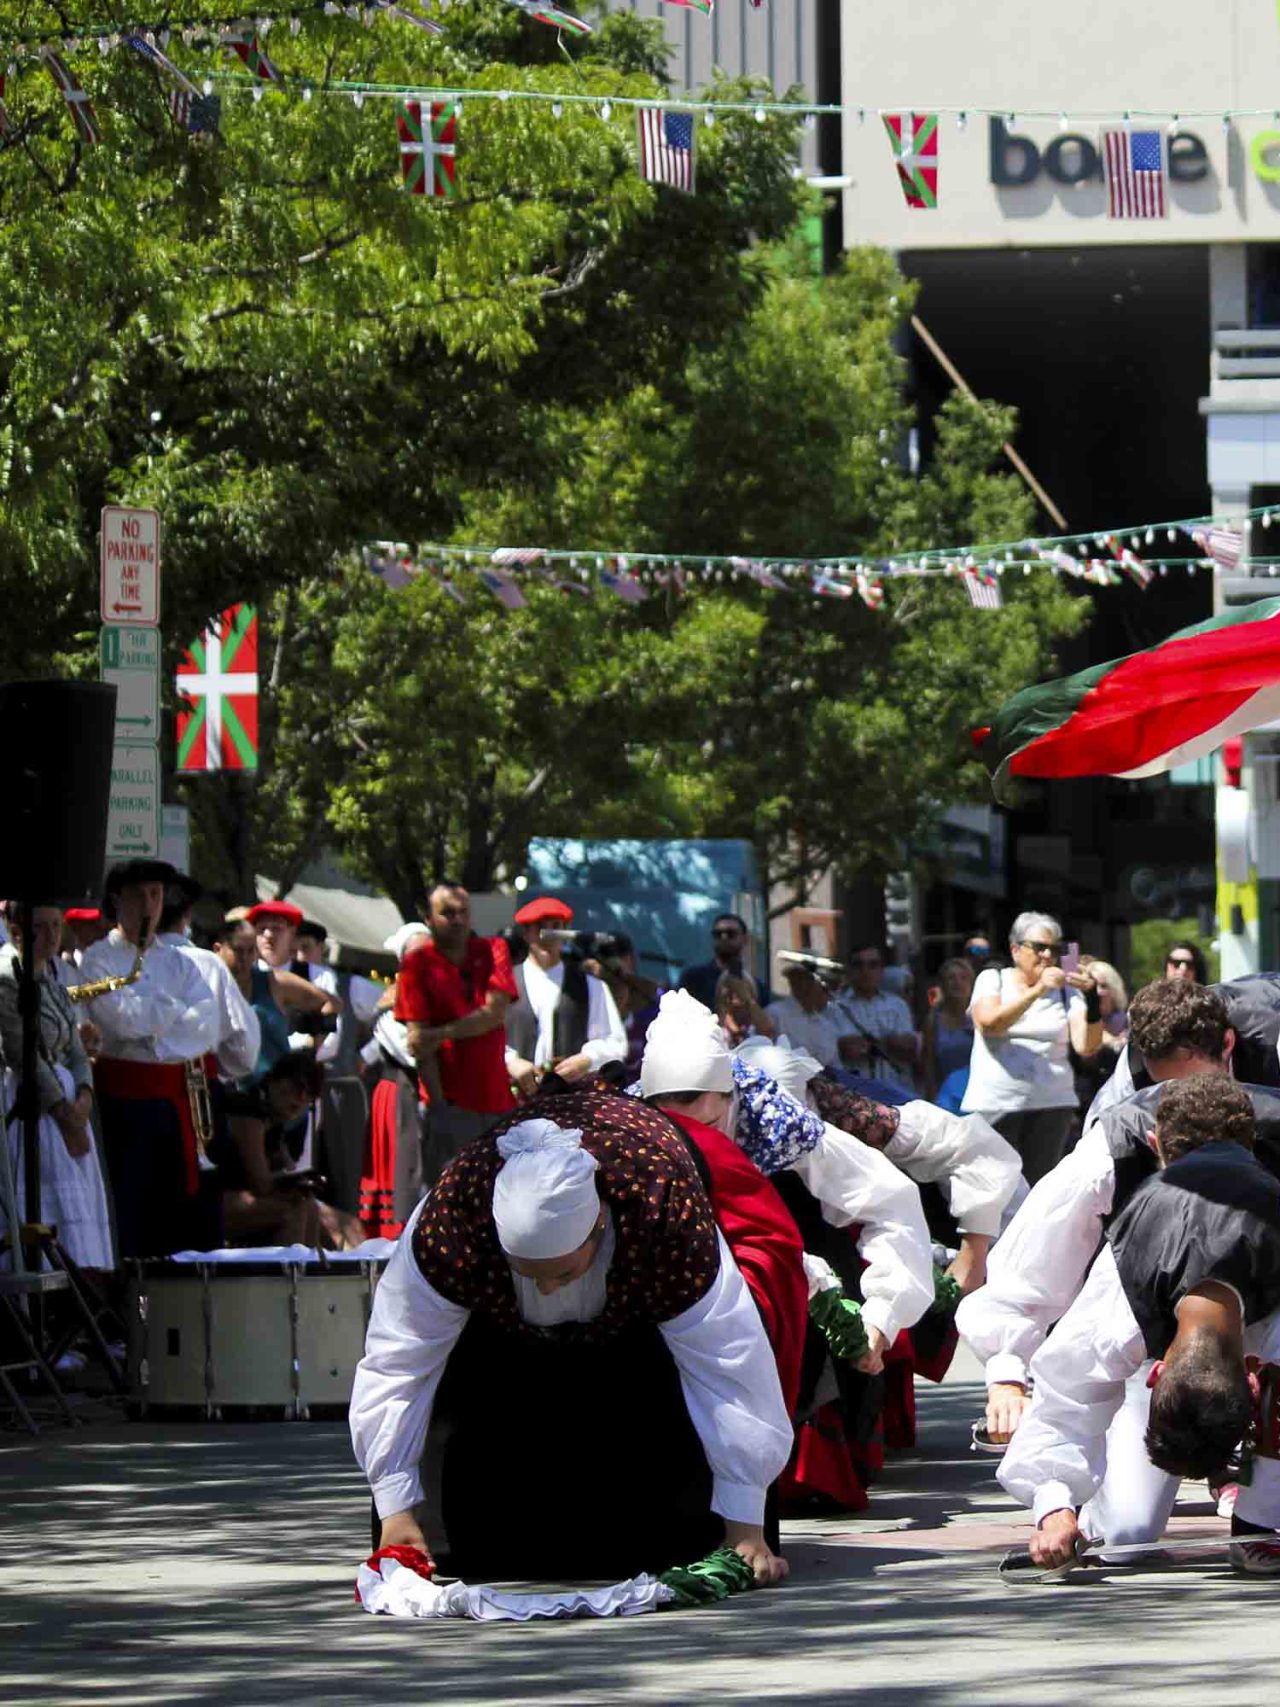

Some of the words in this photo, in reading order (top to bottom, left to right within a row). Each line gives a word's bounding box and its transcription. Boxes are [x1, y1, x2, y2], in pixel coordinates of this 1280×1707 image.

[988, 115, 1209, 185] boe
[122, 520, 140, 538] NO
[107, 541, 154, 563] PARKING
[121, 565, 139, 580] ANY
[121, 583, 140, 600] TIME
[110, 768, 153, 785] ARALLEL
[118, 823, 143, 838] ONLY
